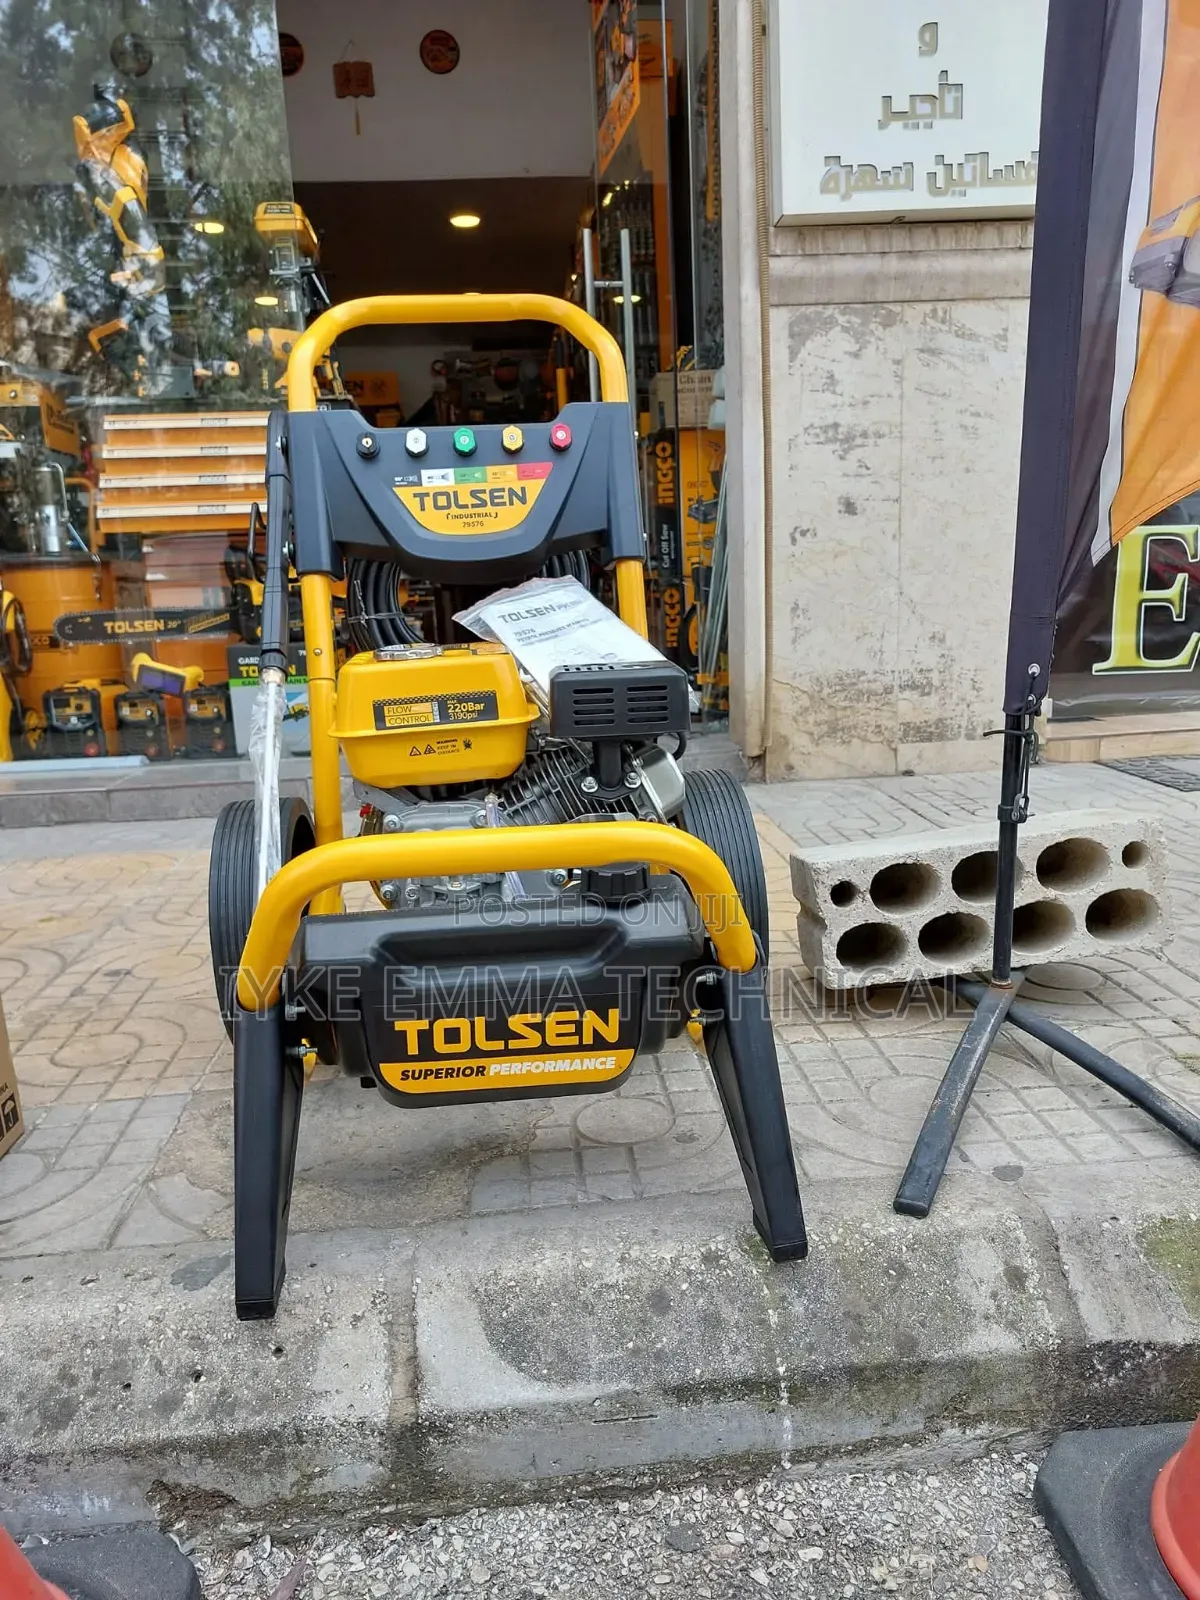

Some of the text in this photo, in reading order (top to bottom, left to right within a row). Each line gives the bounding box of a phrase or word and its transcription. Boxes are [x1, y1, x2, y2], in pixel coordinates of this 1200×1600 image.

[917, 22, 939, 57] و
[819, 155, 914, 202] سهرة
[413, 486, 527, 512] TOLSEN
[450, 512, 494, 520] INDUSTRIAL
[498, 603, 557, 624] TOLSEN
[103, 619, 165, 634] TOLSEN
[387, 706, 412, 714] FLOW
[447, 702, 485, 713] 220Bar
[388, 715, 431, 725] CONTROL
[449, 711, 478, 720] 3190psi
[394, 1008, 619, 1055] TOLSEN
[400, 1057, 616, 1081] SUPERIOR PERFORMANCE
